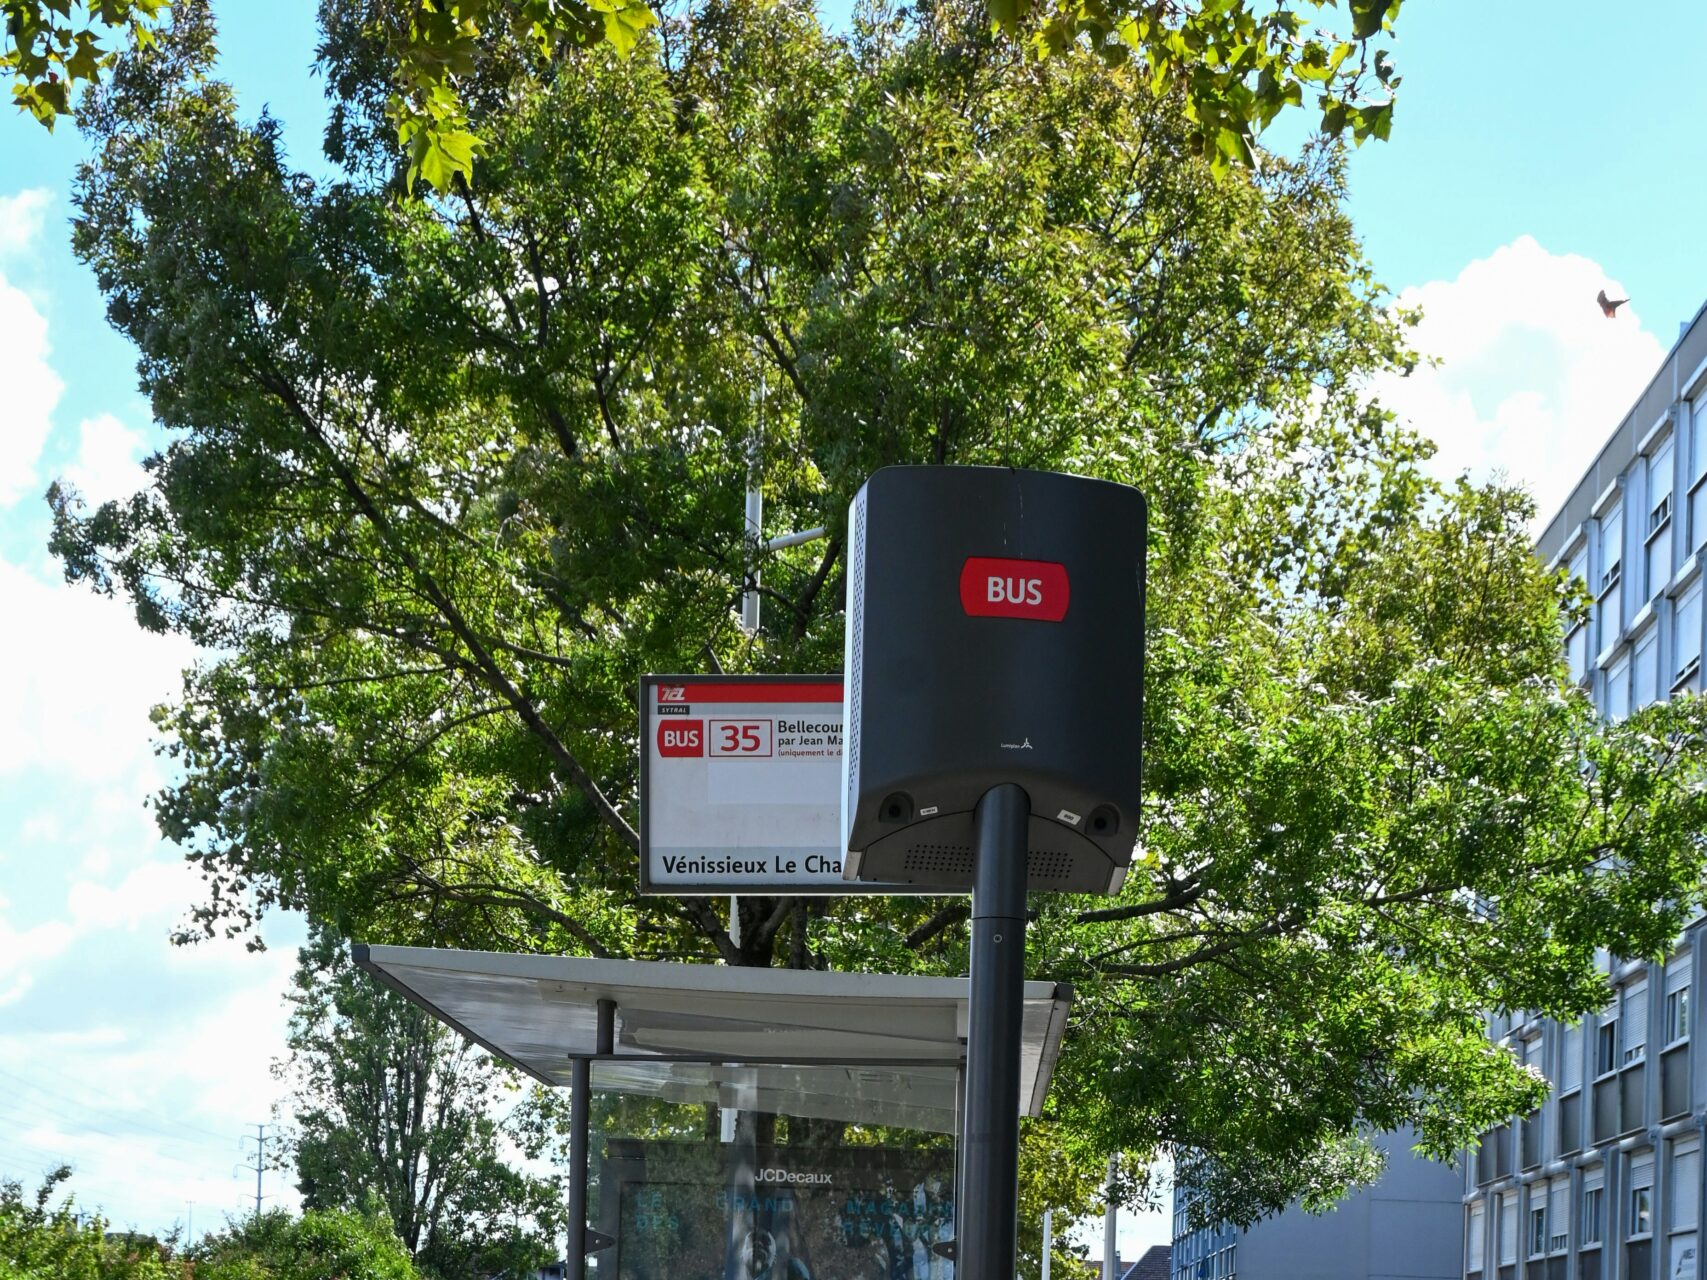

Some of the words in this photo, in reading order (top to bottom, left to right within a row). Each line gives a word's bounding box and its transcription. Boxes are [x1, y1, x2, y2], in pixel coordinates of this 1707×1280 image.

[987, 576, 1042, 605] BUS
[664, 730, 699, 747] BUS
[720, 725, 761, 752] 35
[778, 738, 796, 748] par
[799, 735, 823, 745] Jean
[778, 748, 825, 758] (uniquement
[662, 855, 767, 874] Vénissieux
[775, 855, 797, 874] Le
[755, 1168, 832, 1184] JCDecaux
